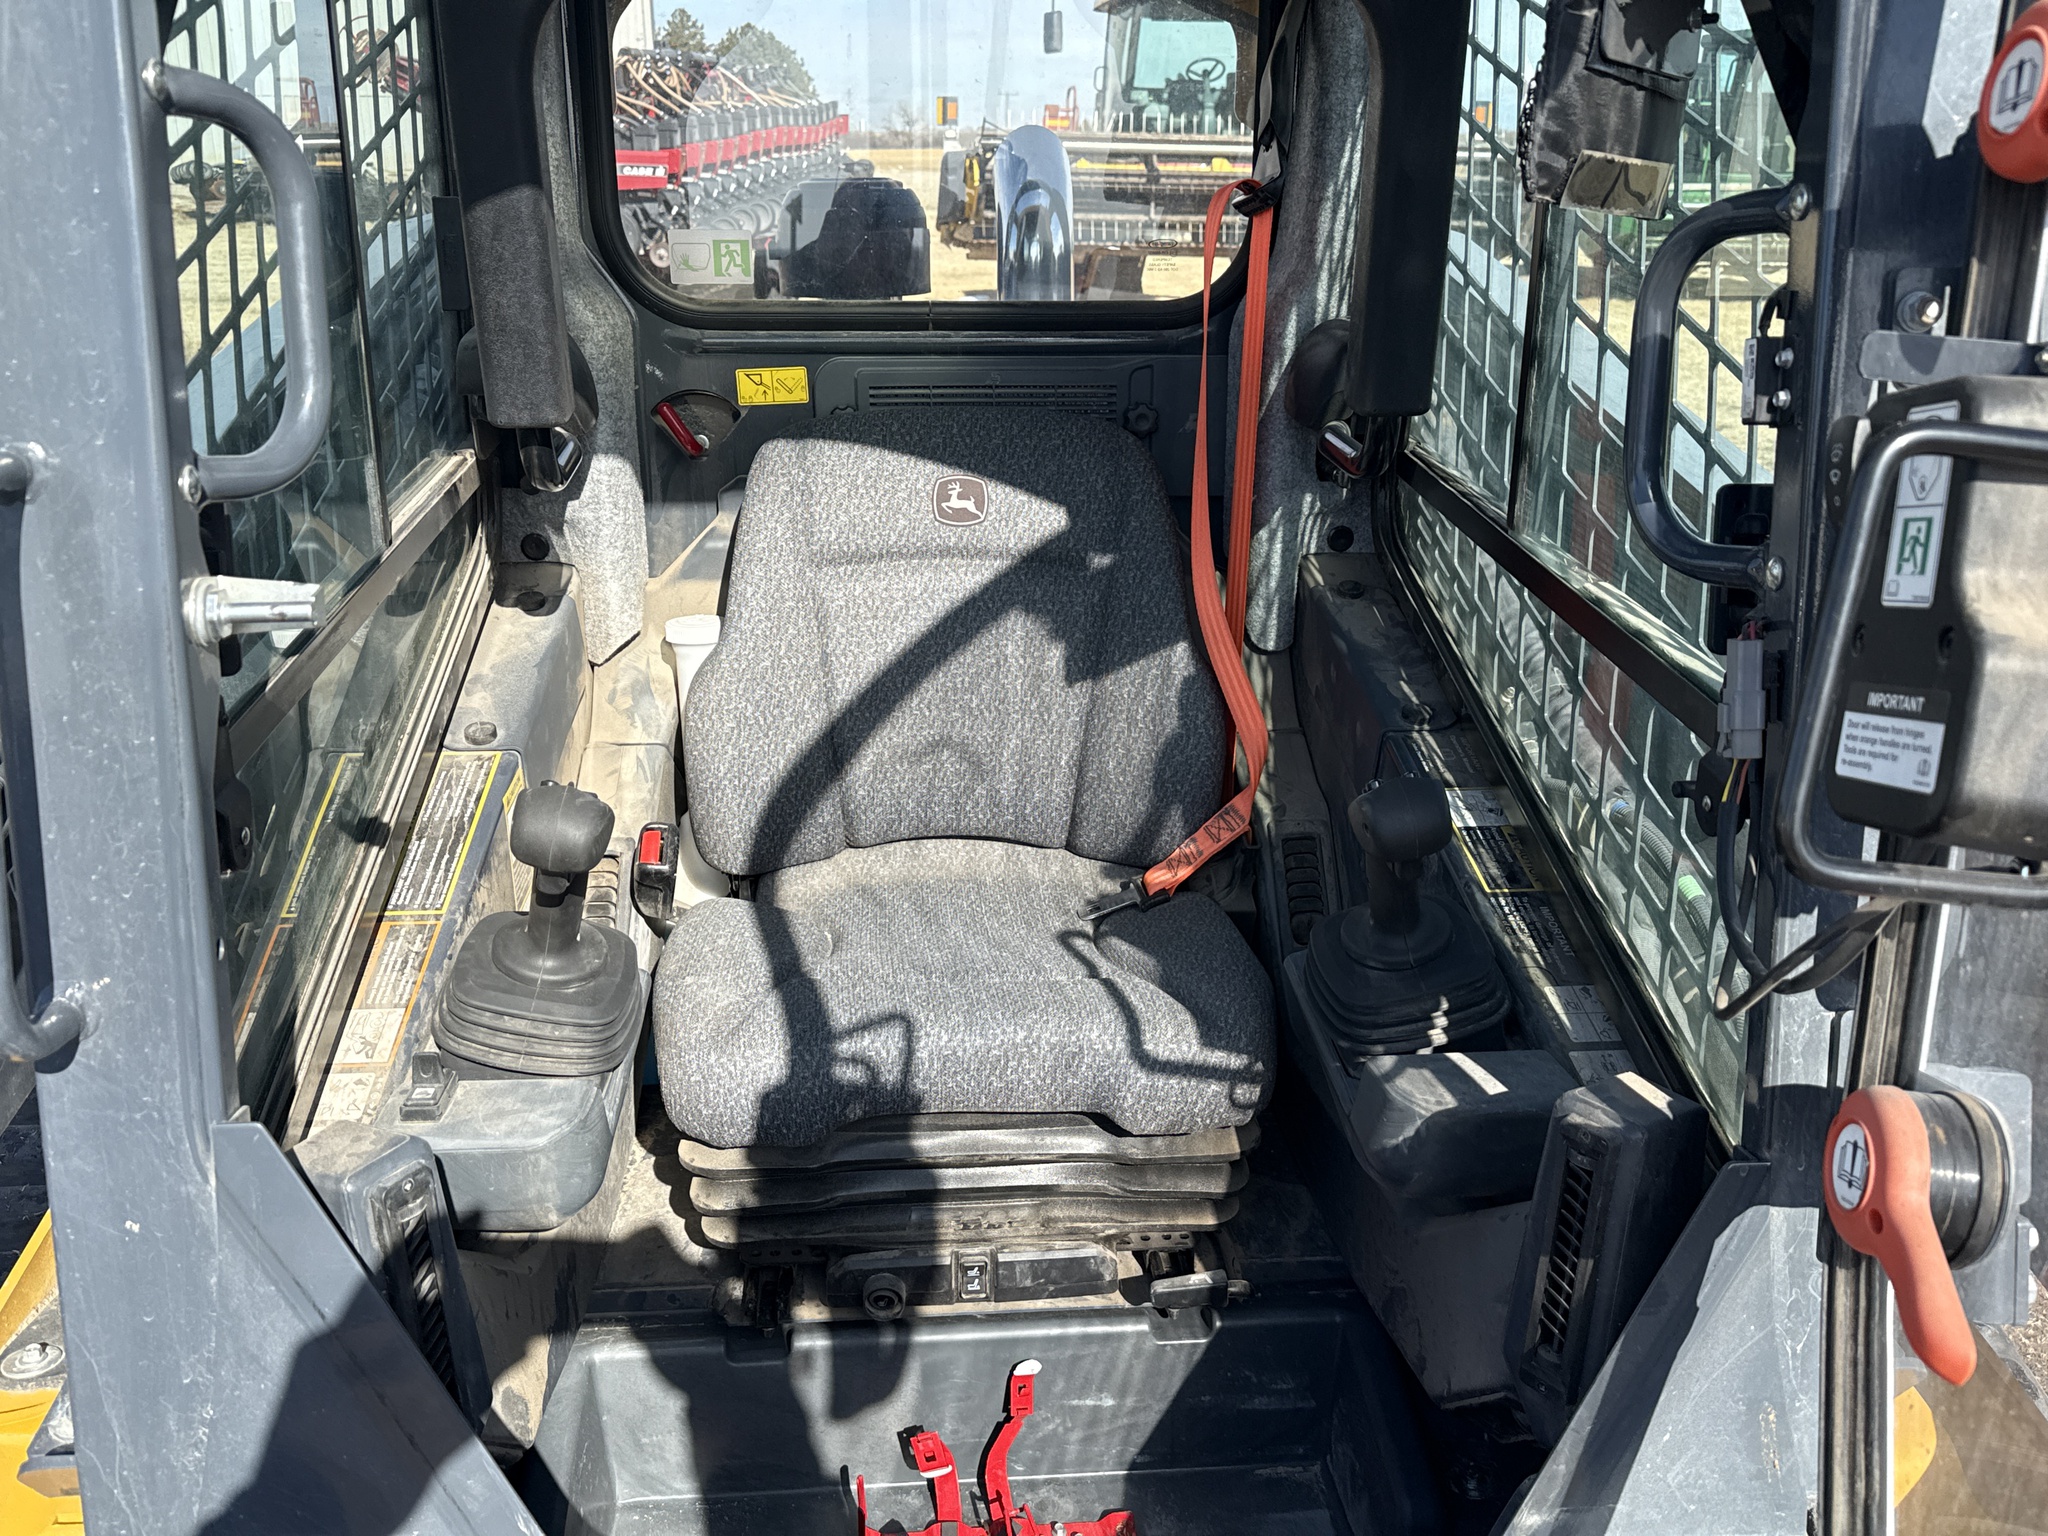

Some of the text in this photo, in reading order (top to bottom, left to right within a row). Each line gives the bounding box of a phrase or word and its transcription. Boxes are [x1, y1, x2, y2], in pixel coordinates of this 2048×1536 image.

[622, 166, 654, 176] CASE
[1867, 691, 1926, 713] IMPORTANT
[1847, 719, 1860, 728] Door
[1861, 722, 1870, 730] will
[1871, 723, 1889, 733] release
[1891, 725, 1903, 735] from
[1845, 733, 1858, 741] when
[1859, 735, 1878, 746] orange
[1879, 738, 1900, 748] handles
[1844, 744, 1898, 761] Tools are required for
[1540, 906, 1574, 957] IMPORTANT
